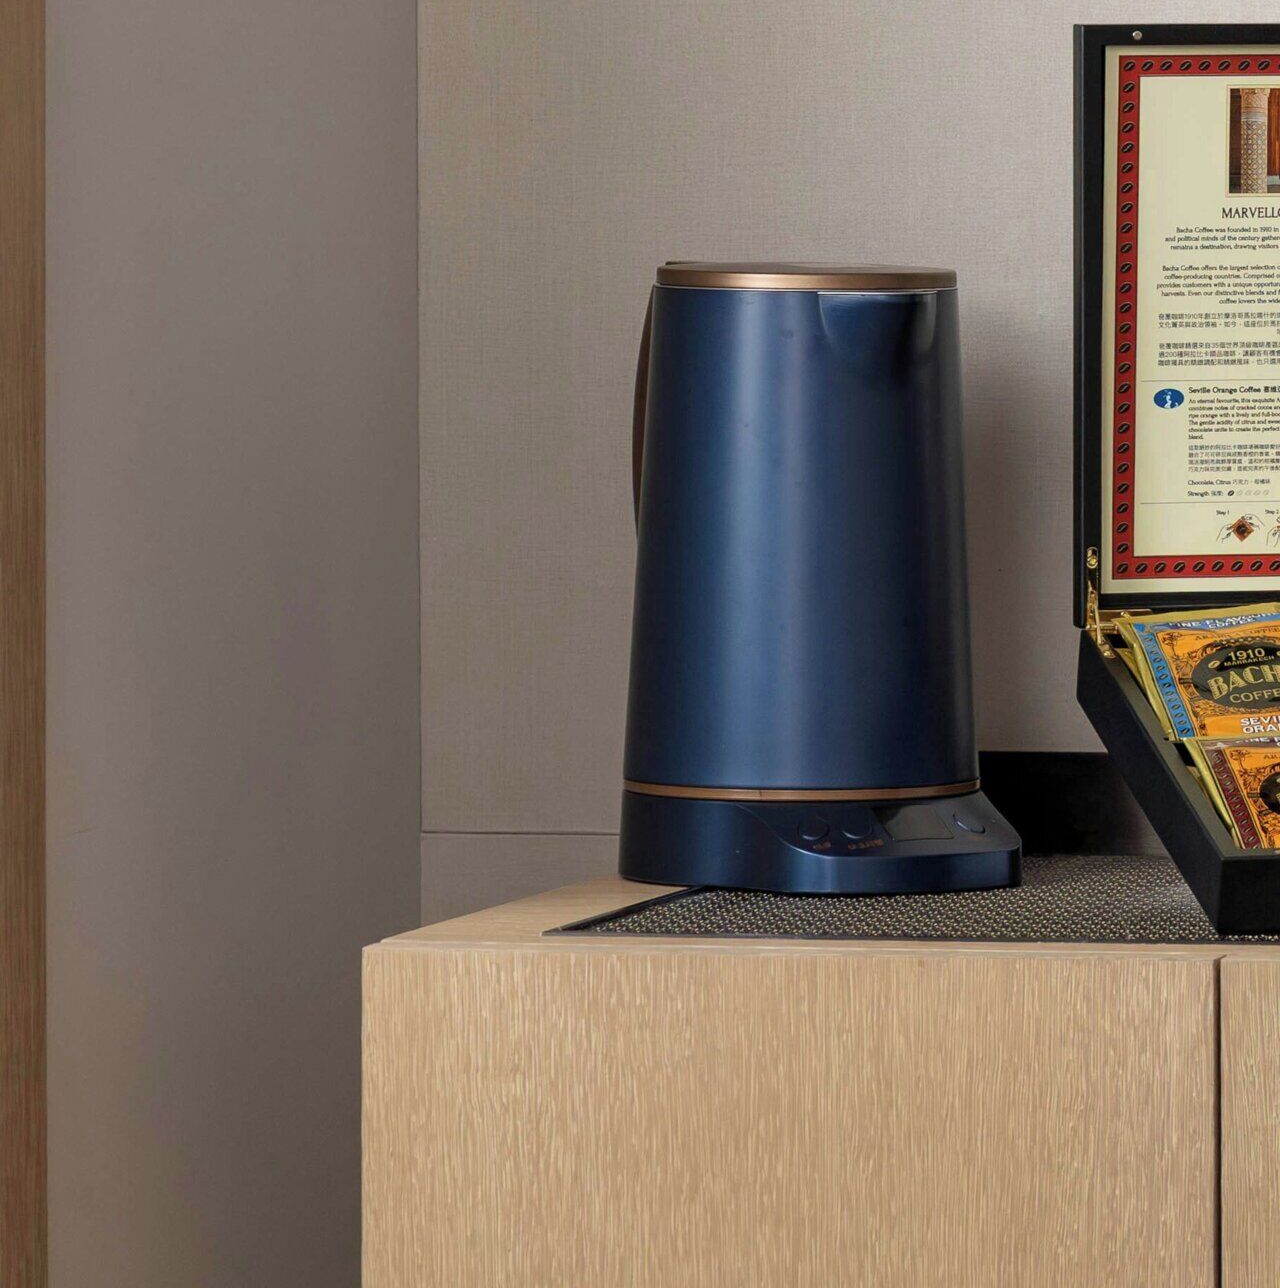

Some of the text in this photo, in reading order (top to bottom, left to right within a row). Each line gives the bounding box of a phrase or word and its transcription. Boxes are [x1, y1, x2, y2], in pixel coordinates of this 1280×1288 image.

[1177, 235, 1199, 243] political
[1227, 648, 1265, 661] 1910
[1224, 655, 1275, 667] MARRAKECH
